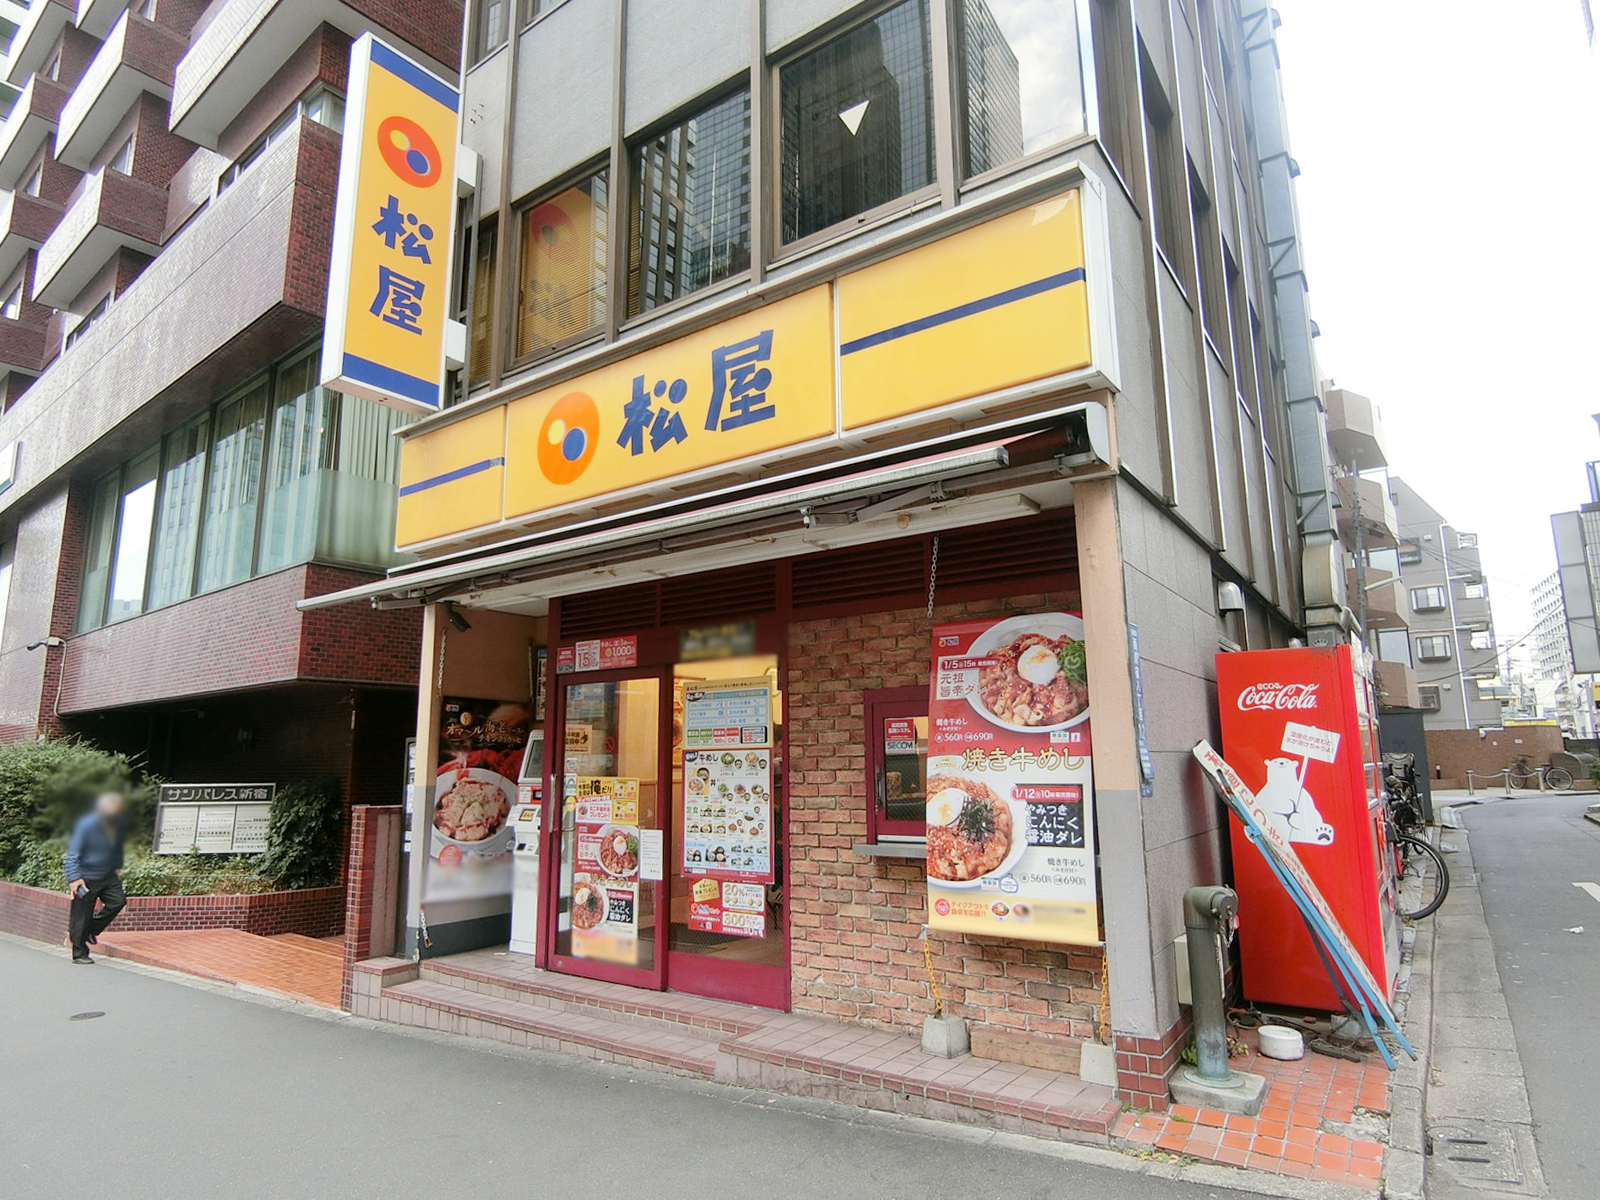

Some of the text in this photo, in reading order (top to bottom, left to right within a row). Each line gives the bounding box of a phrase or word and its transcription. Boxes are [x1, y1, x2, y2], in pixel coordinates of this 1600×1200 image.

[369, 194, 435, 335] 松屋
[616, 328, 776, 457] 松屋
[941, 673, 964, 685] 元祖
[940, 684, 987, 698] 旨辛ダレ
[936, 718, 968, 726] 焼き牛めし
[887, 741, 913, 750] SECOM
[699, 753, 719, 762] 牛めし
[962, 746, 1085, 772] 焼き牛めし
[168, 788, 268, 800] サンパレス新宿
[728, 807, 744, 816] カレー
[1025, 804, 1068, 816] やみつき
[1025, 815, 1079, 830] にんにく
[1026, 829, 1083, 845] 醤油ダレ
[1047, 858, 1085, 867] 焼き牛めし
[724, 913, 746, 927] 300
